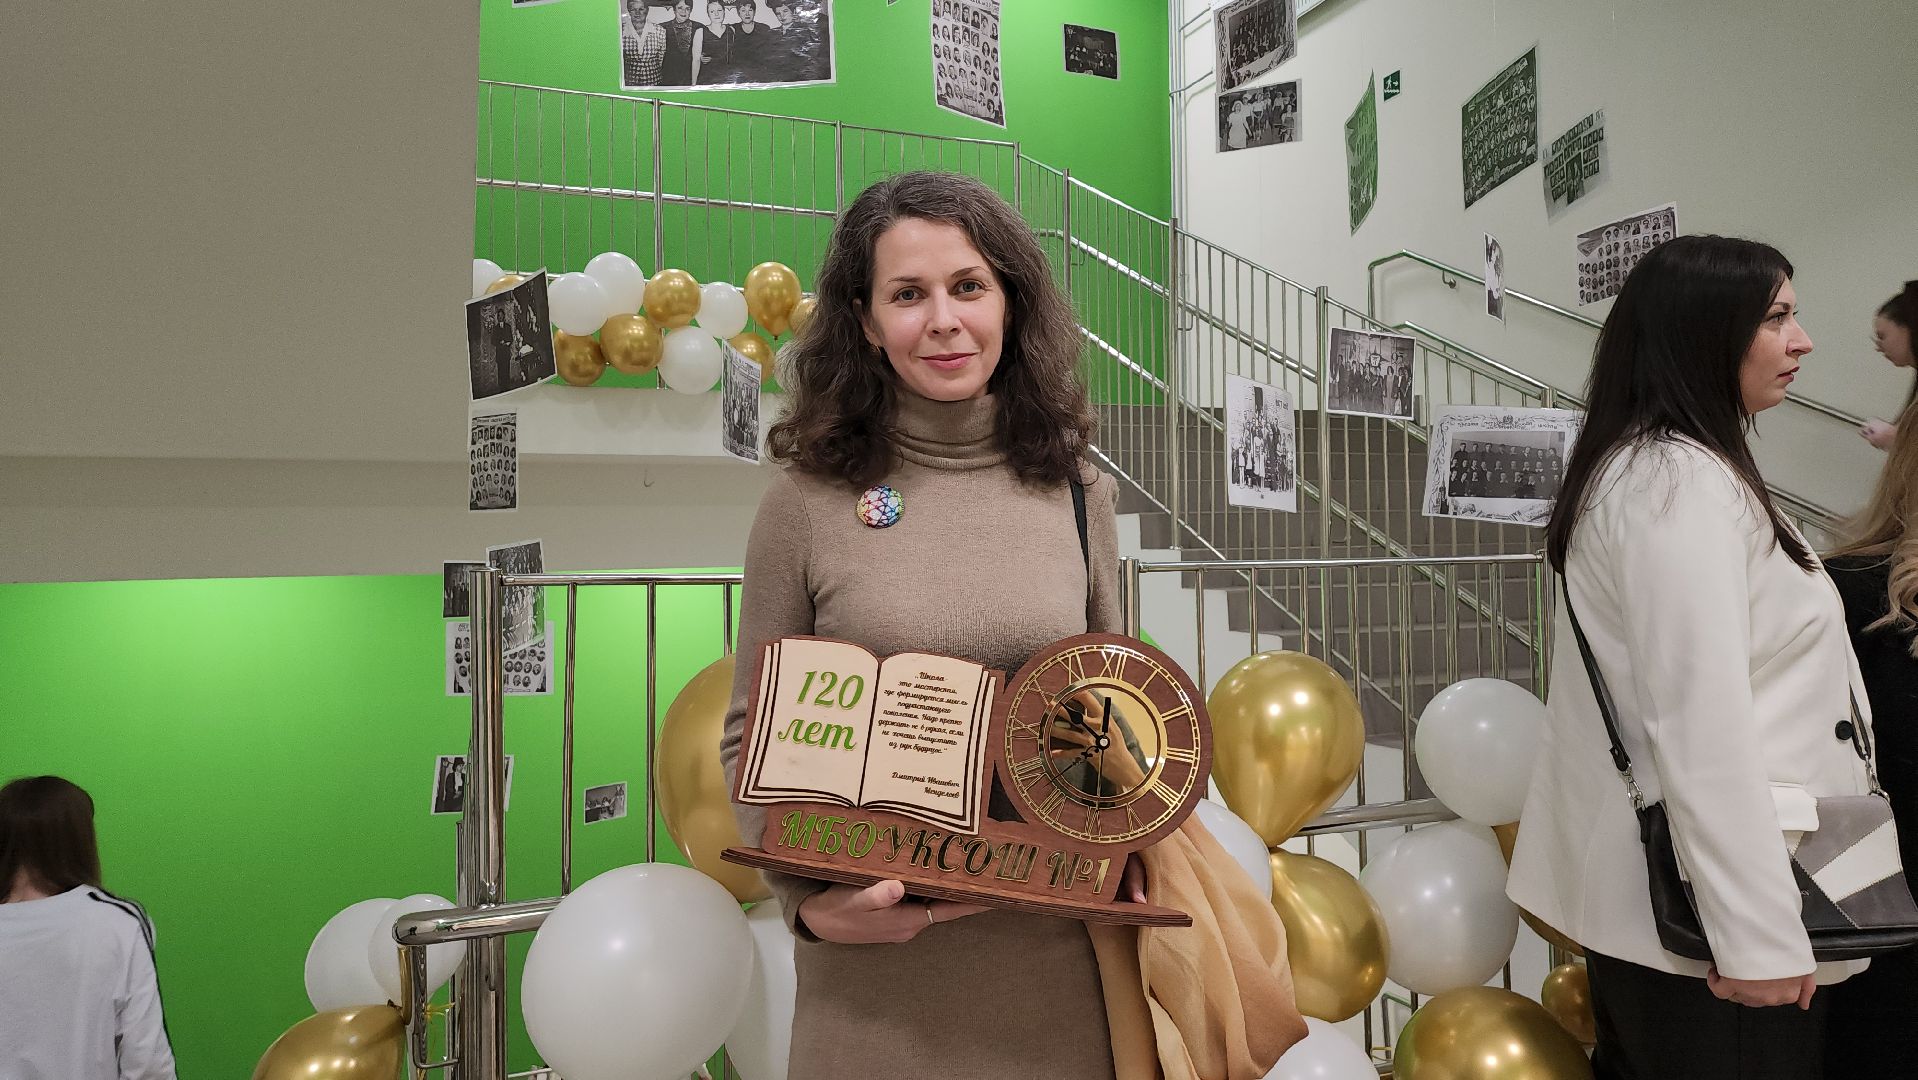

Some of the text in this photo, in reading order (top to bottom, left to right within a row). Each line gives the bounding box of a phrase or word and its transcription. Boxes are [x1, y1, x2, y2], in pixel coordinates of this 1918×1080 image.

[796, 670, 865, 710] 120
[896, 690, 945, 702] формируется
[945, 698, 968, 706] мысль
[897, 701, 952, 714] подрастающего
[921, 713, 939, 723] Надо
[939, 717, 963, 726] крепко
[777, 718, 859, 751] лет
[878, 719, 911, 729] держать
[948, 729, 965, 737] если
[888, 741, 898, 749] из
[899, 742, 912, 751] рук
[892, 731, 917, 740] хочешь
[917, 733, 958, 746] выпустить
[891, 771, 961, 788] Дмитрий Иванович
[924, 786, 960, 799] Менделеев
